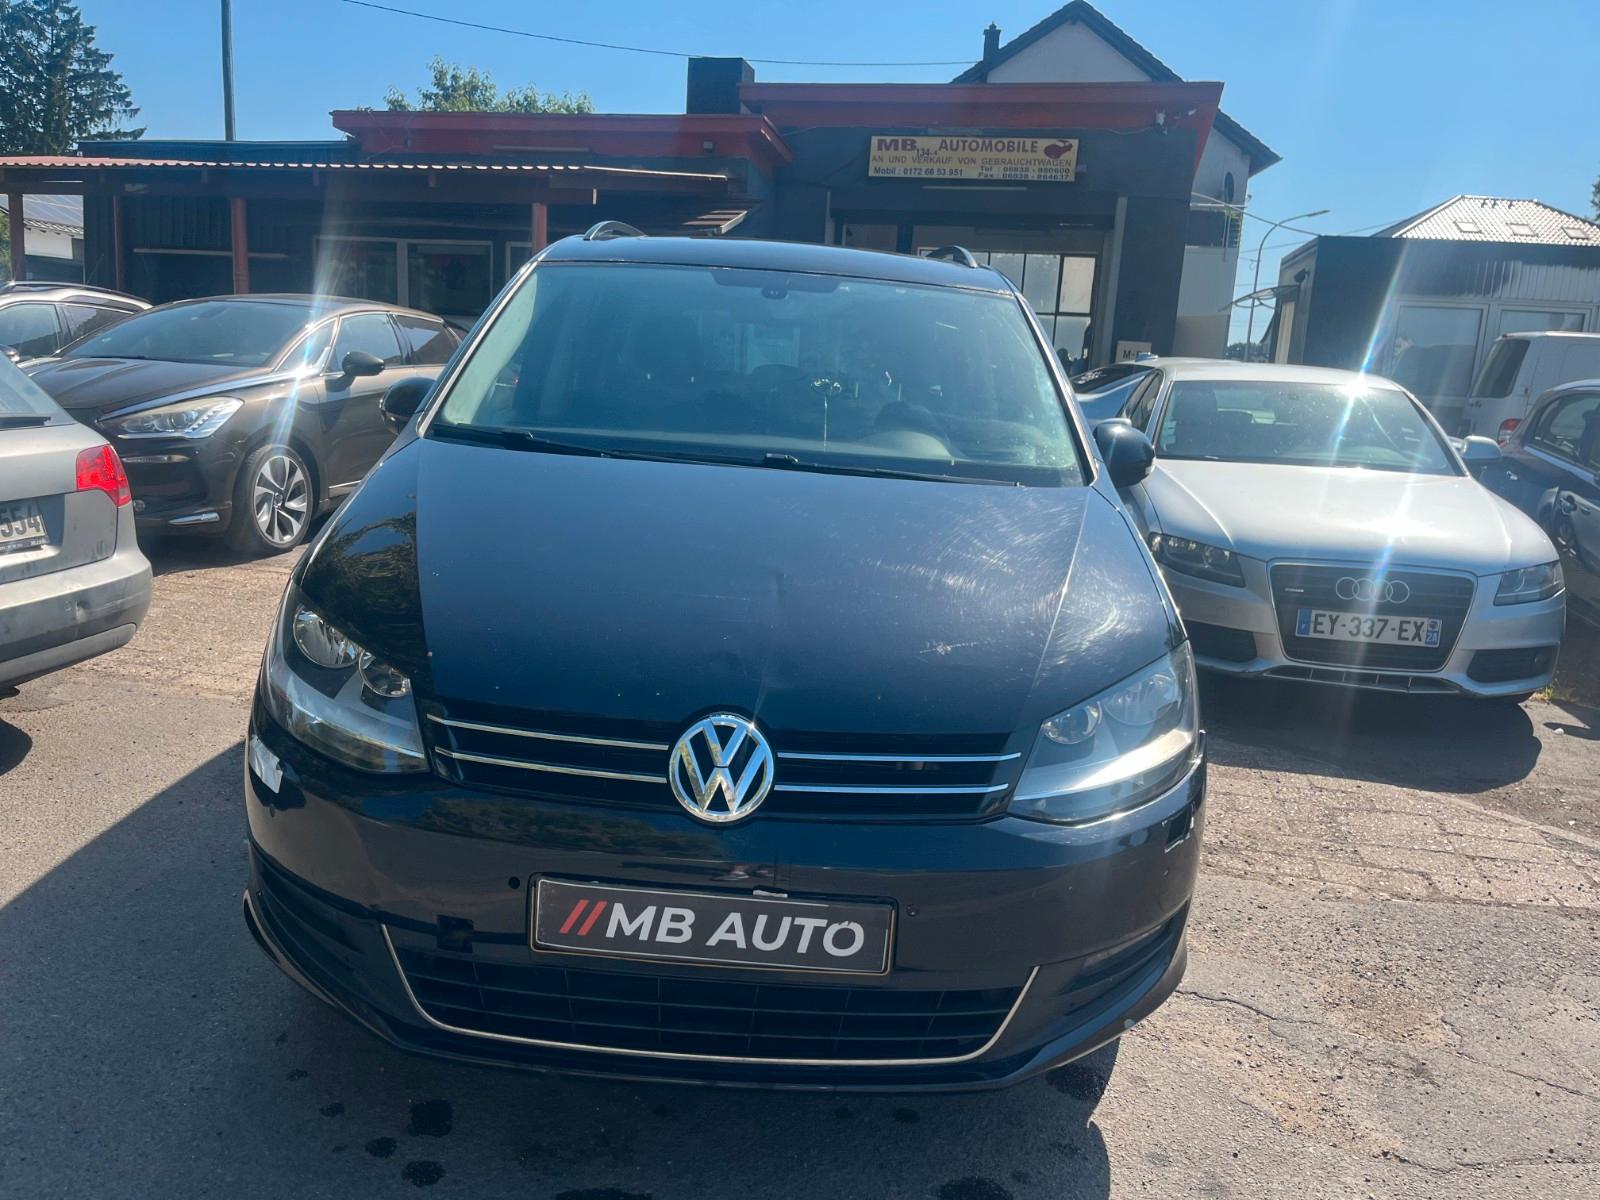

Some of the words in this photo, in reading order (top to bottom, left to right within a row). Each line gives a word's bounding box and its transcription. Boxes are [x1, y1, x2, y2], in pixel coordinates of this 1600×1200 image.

[877, 139, 917, 151] MB
[939, 140, 1038, 153] AUTOMOBILE
[872, 155, 884, 163] AN
[889, 156, 907, 164] UND
[912, 156, 953, 165] VERKAUF
[959, 157, 977, 165] VON
[980, 158, 1072, 167] GEBRAUCHTWAGEN
[874, 167, 896, 175] Mobil
[903, 168, 922, 176] 0172
[1312, 613, 1425, 642] EY-337-EX
[1426, 634, 1438, 643] 2A
[605, 902, 696, 944] MB
[705, 911, 865, 957] AUTO
